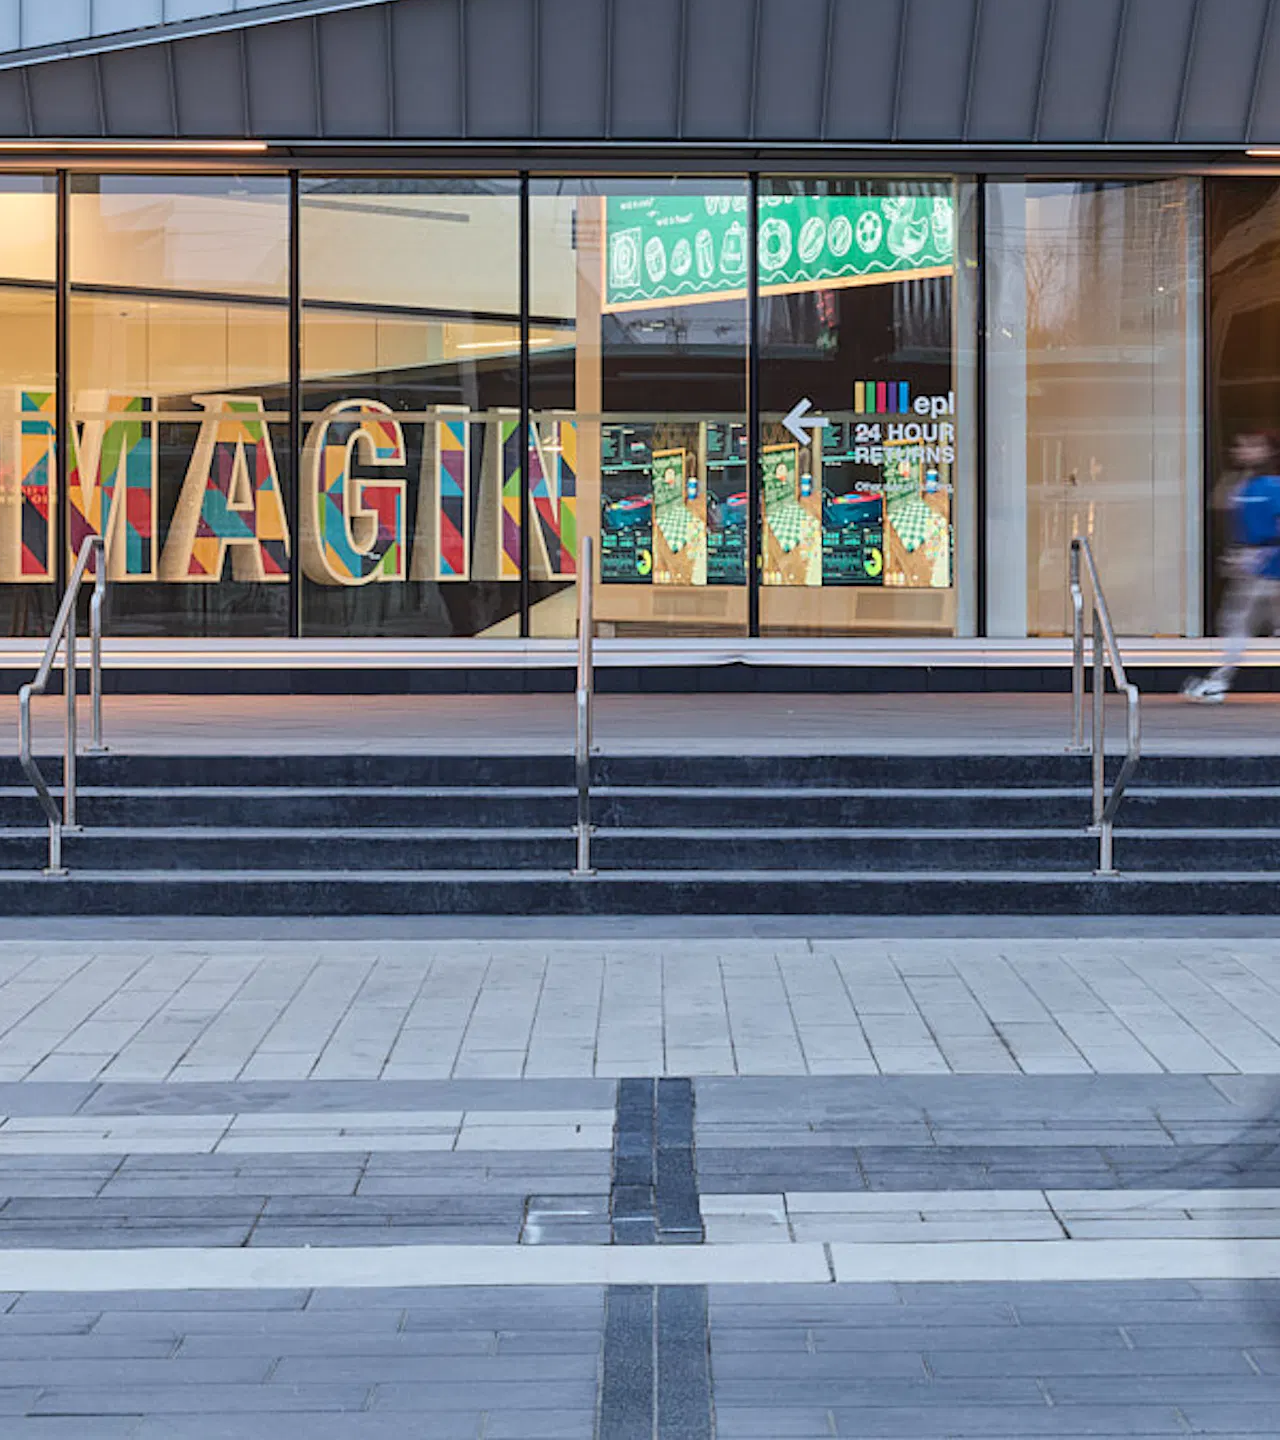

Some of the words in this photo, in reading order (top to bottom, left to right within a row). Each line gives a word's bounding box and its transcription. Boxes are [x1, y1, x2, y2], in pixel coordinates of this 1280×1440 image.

[913, 391, 955, 419] epl
[854, 423, 882, 443] 24
[887, 423, 955, 443] HOUR
[854, 446, 955, 464] RETURNS
